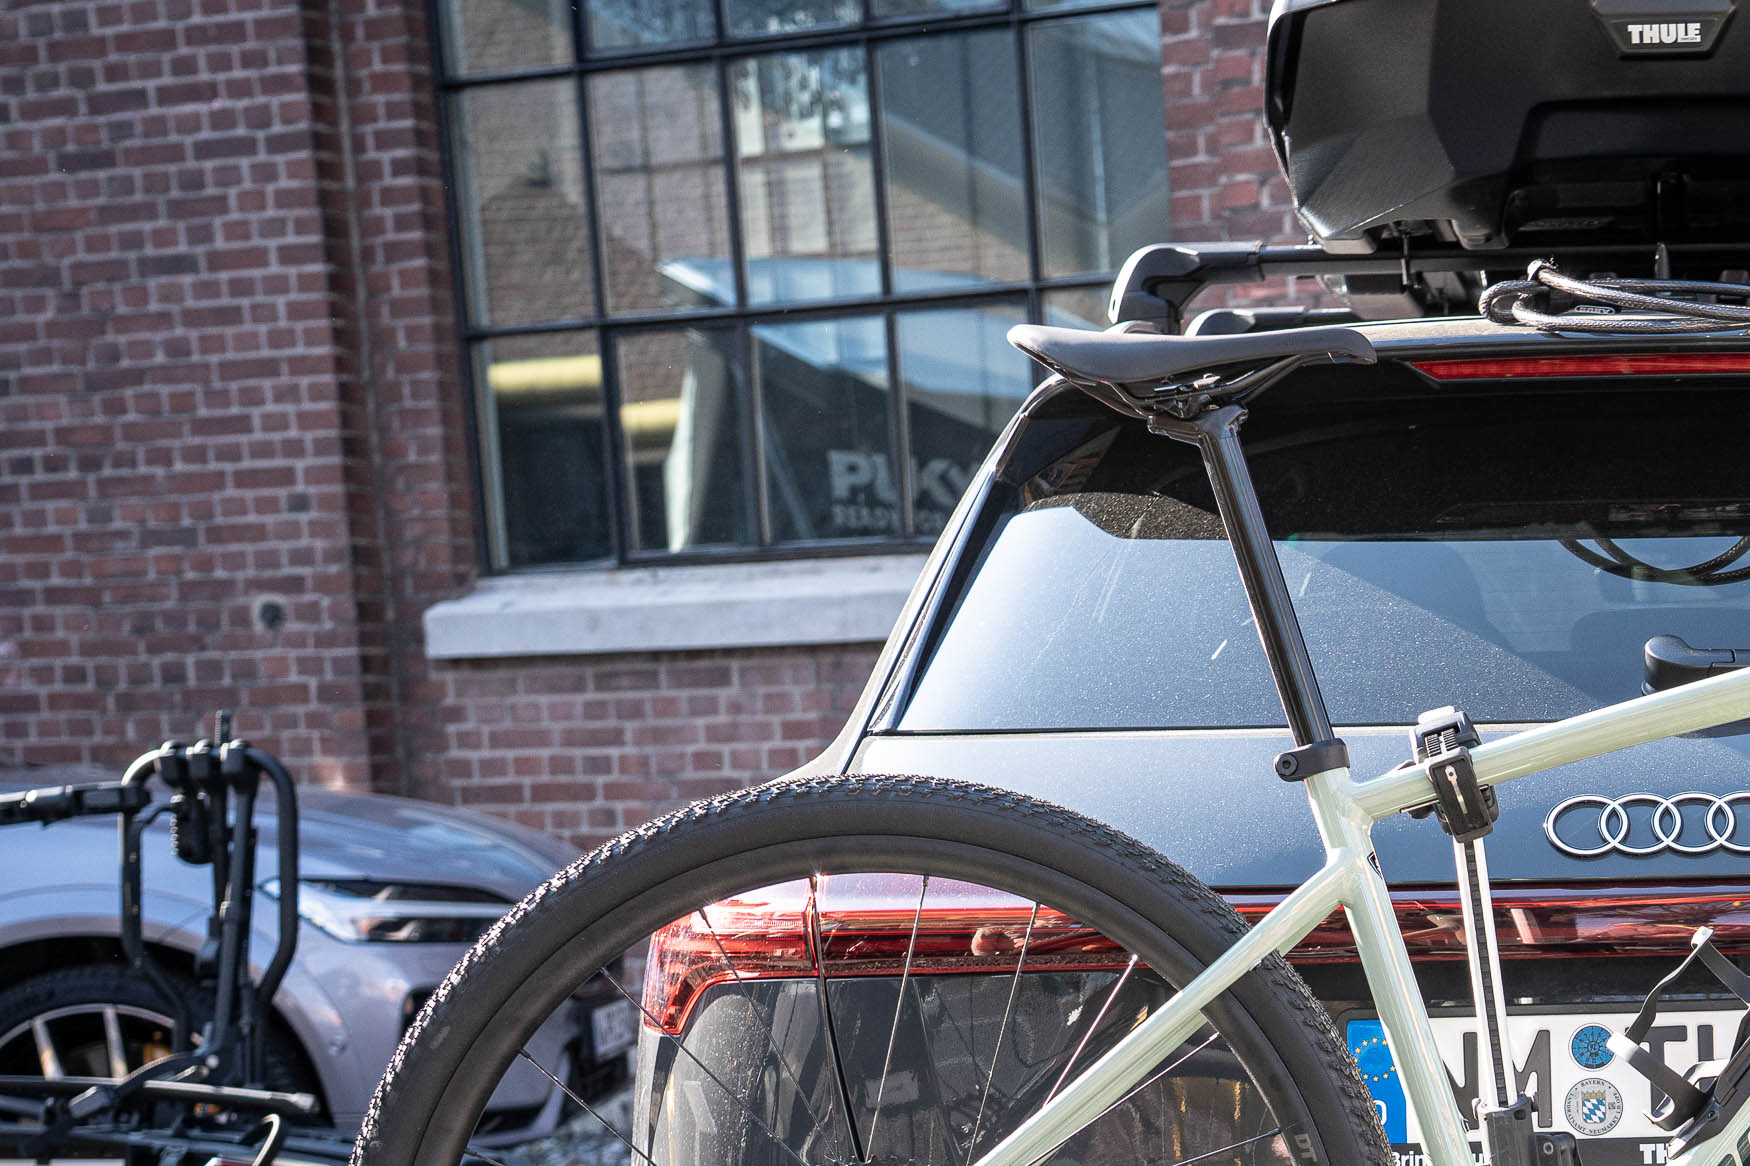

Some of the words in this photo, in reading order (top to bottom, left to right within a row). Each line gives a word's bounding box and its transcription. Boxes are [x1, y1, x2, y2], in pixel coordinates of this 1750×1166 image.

[1627, 22, 1702, 44] THULE
[1580, 1080, 1606, 1088] BAYERN
[1294, 1133, 1318, 1162] DT
